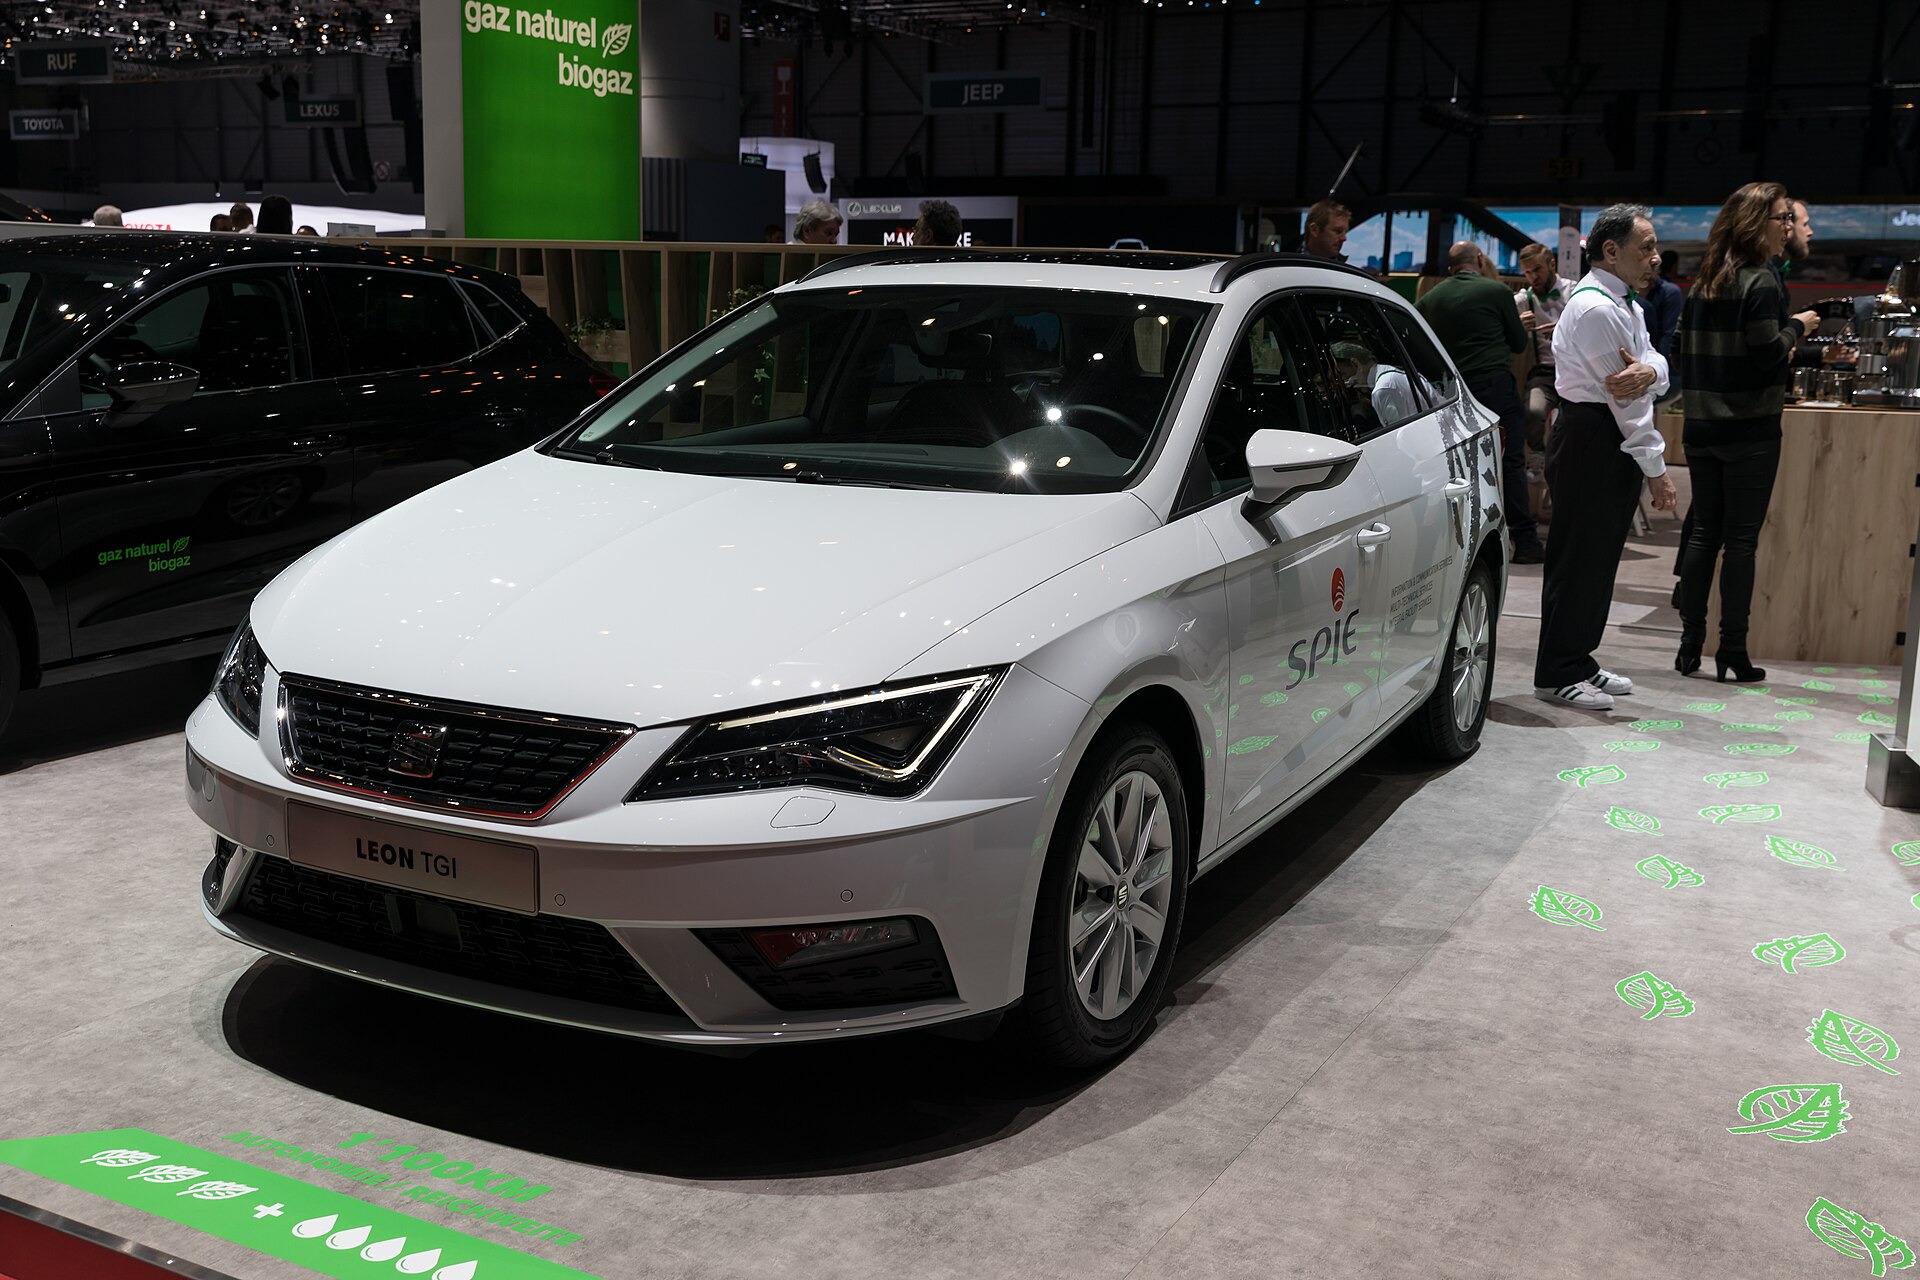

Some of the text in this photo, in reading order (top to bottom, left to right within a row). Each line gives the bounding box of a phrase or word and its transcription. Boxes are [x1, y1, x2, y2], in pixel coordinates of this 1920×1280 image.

[465, 1, 596, 48] gaz naturel
[47, 53, 77, 70] RUF
[559, 53, 633, 97] biogaz
[962, 83, 1004, 105] JEEP
[22, 117, 64, 131] TOYOTA
[300, 104, 340, 117] LEXUS
[1892, 209, 1920, 226] Je
[98, 538, 170, 565] gaz naturel
[148, 555, 191, 572] biogaz
[1285, 608, 1359, 691] SPIE
[356, 837, 456, 879] LEON TGI
[336, 1133, 553, 1203] 1'100KM
[219, 1131, 392, 1187] AUTONOMIE
[401, 1185, 585, 1247] REICHWEITE
